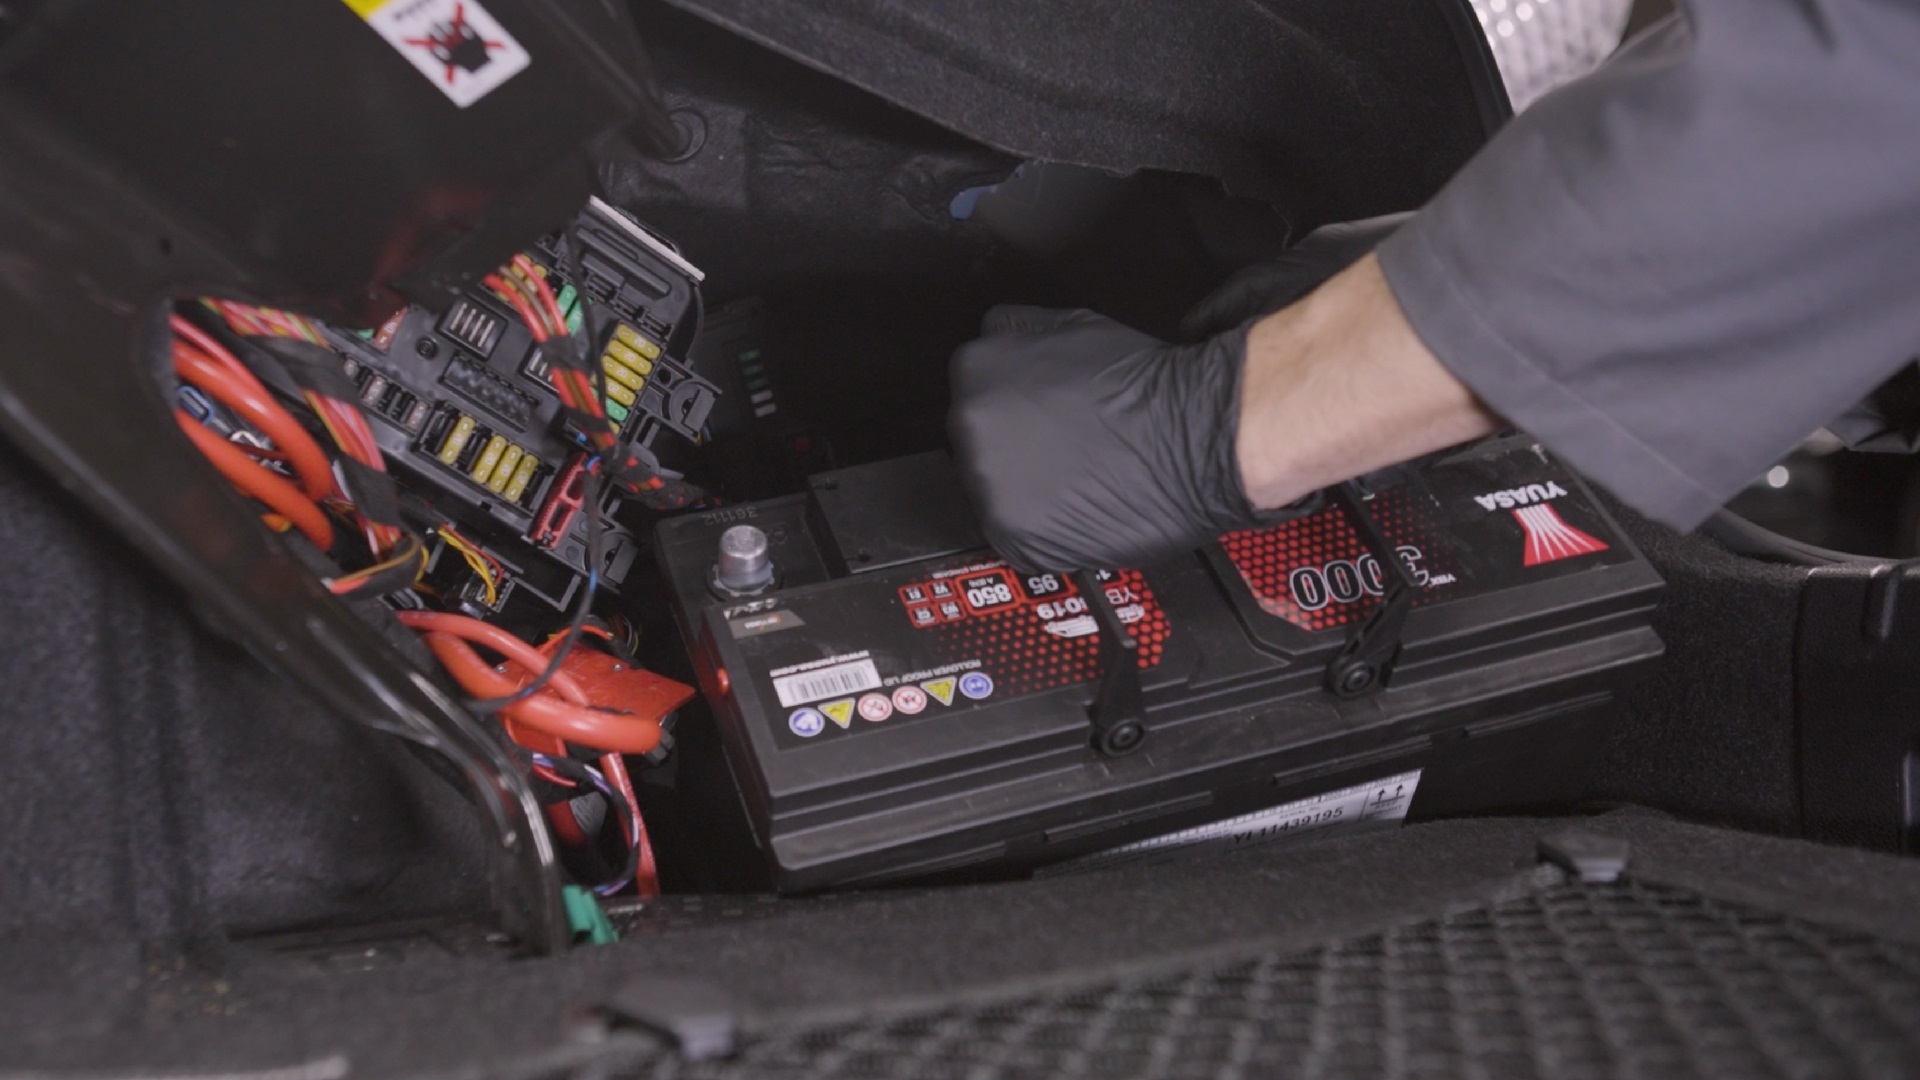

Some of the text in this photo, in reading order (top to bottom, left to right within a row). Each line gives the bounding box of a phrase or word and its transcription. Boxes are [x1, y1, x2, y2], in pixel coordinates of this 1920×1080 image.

[1474, 481, 1568, 511] YUASA
[967, 583, 1012, 607] 850
[1028, 574, 1059, 594] 95
